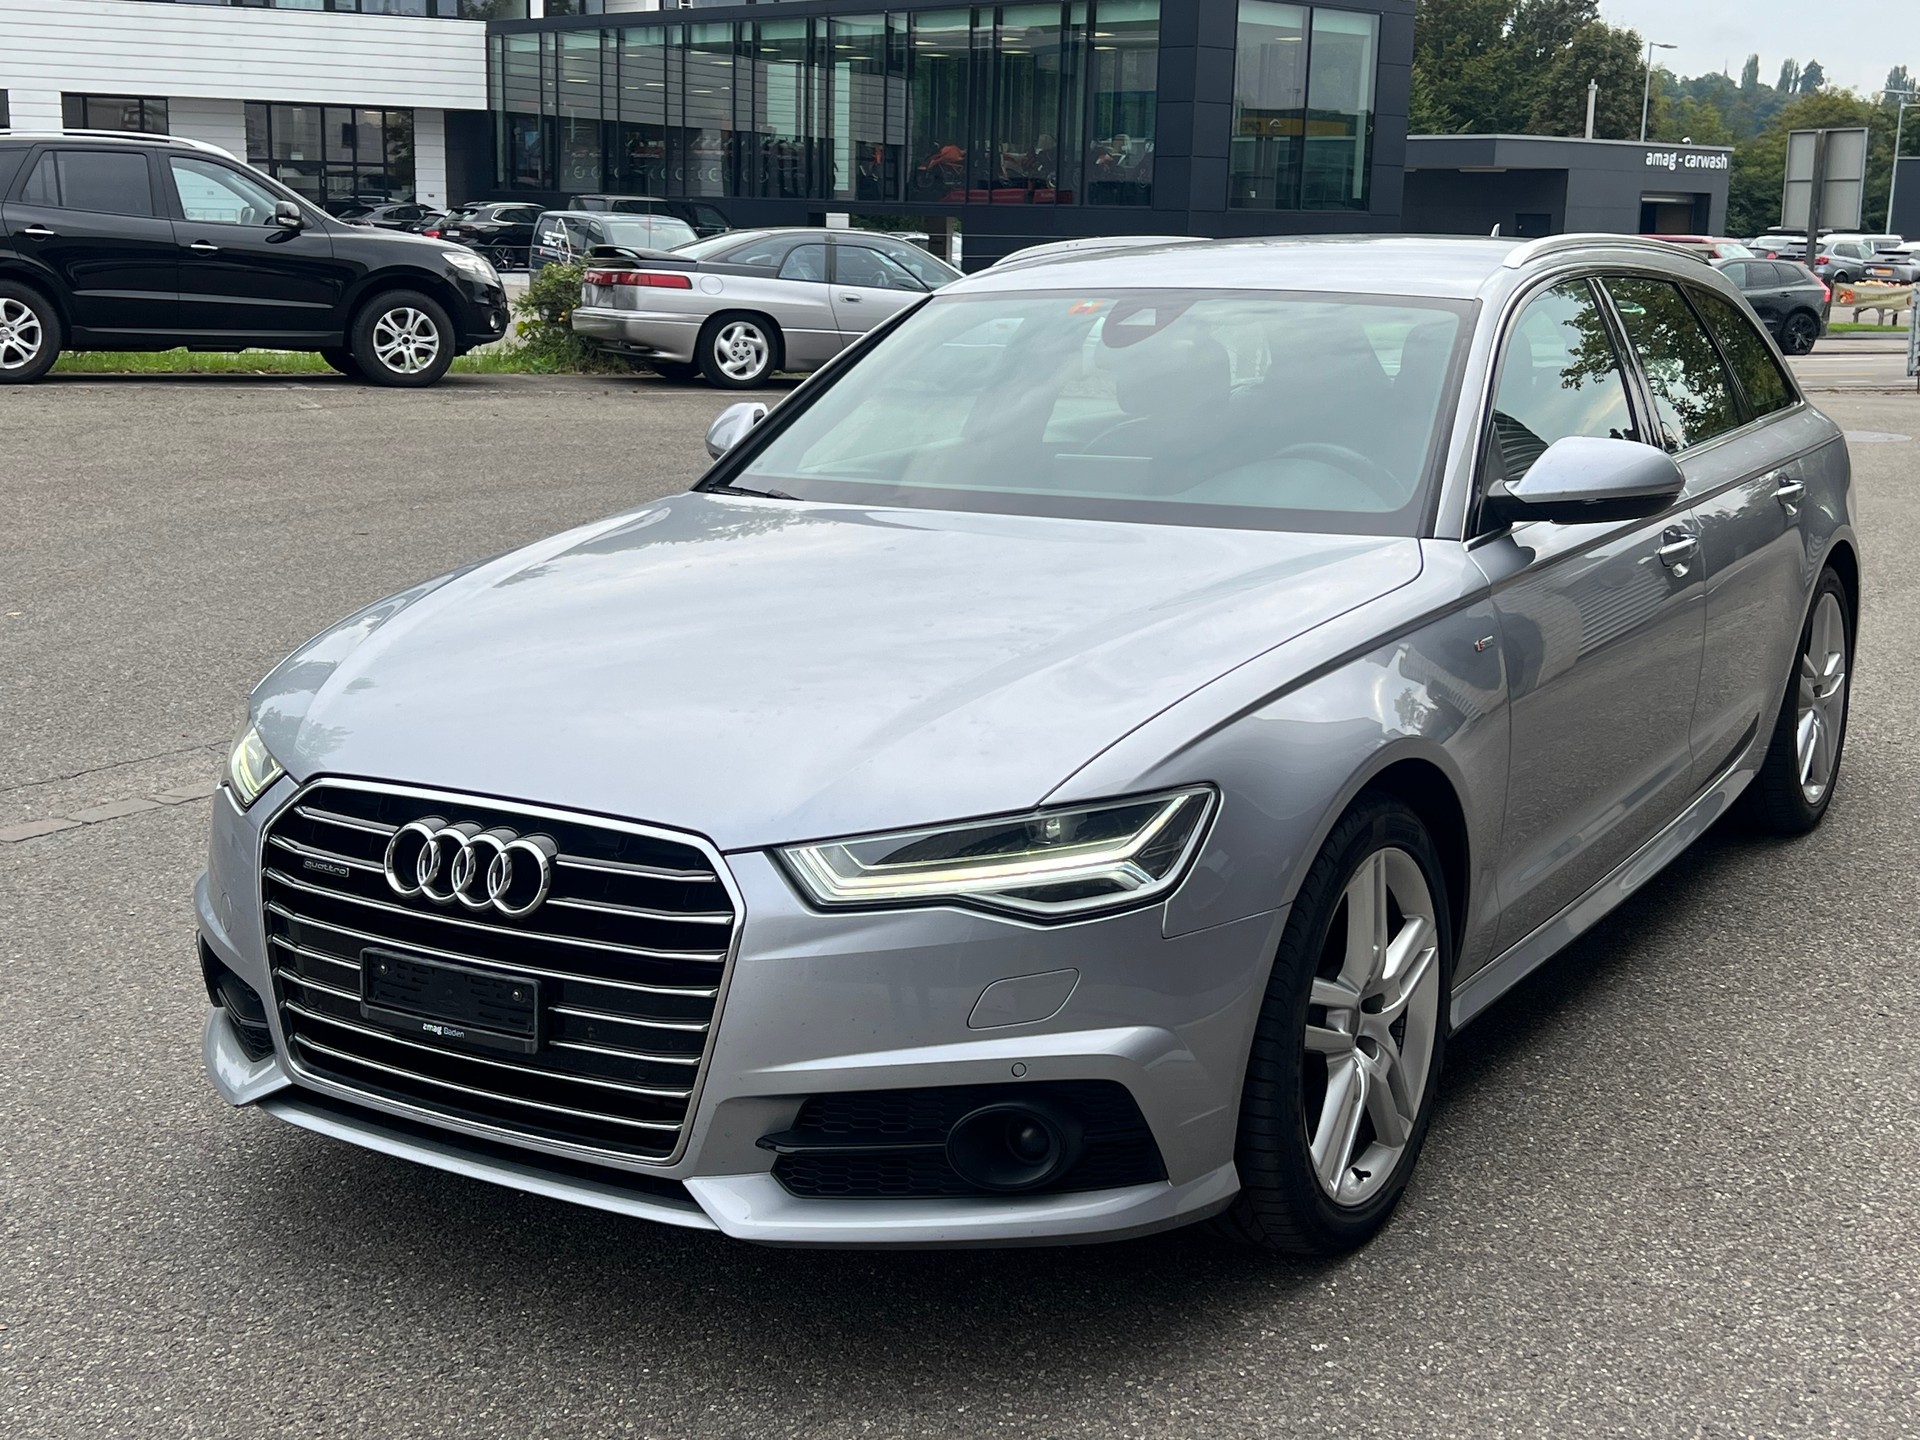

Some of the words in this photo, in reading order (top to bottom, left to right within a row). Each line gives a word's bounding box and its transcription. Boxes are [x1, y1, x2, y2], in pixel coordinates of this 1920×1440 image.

[1646, 152, 1677, 170] amag
[1685, 153, 1728, 170] carwash
[305, 860, 346, 875] quattro
[444, 1027, 464, 1038] Baden
